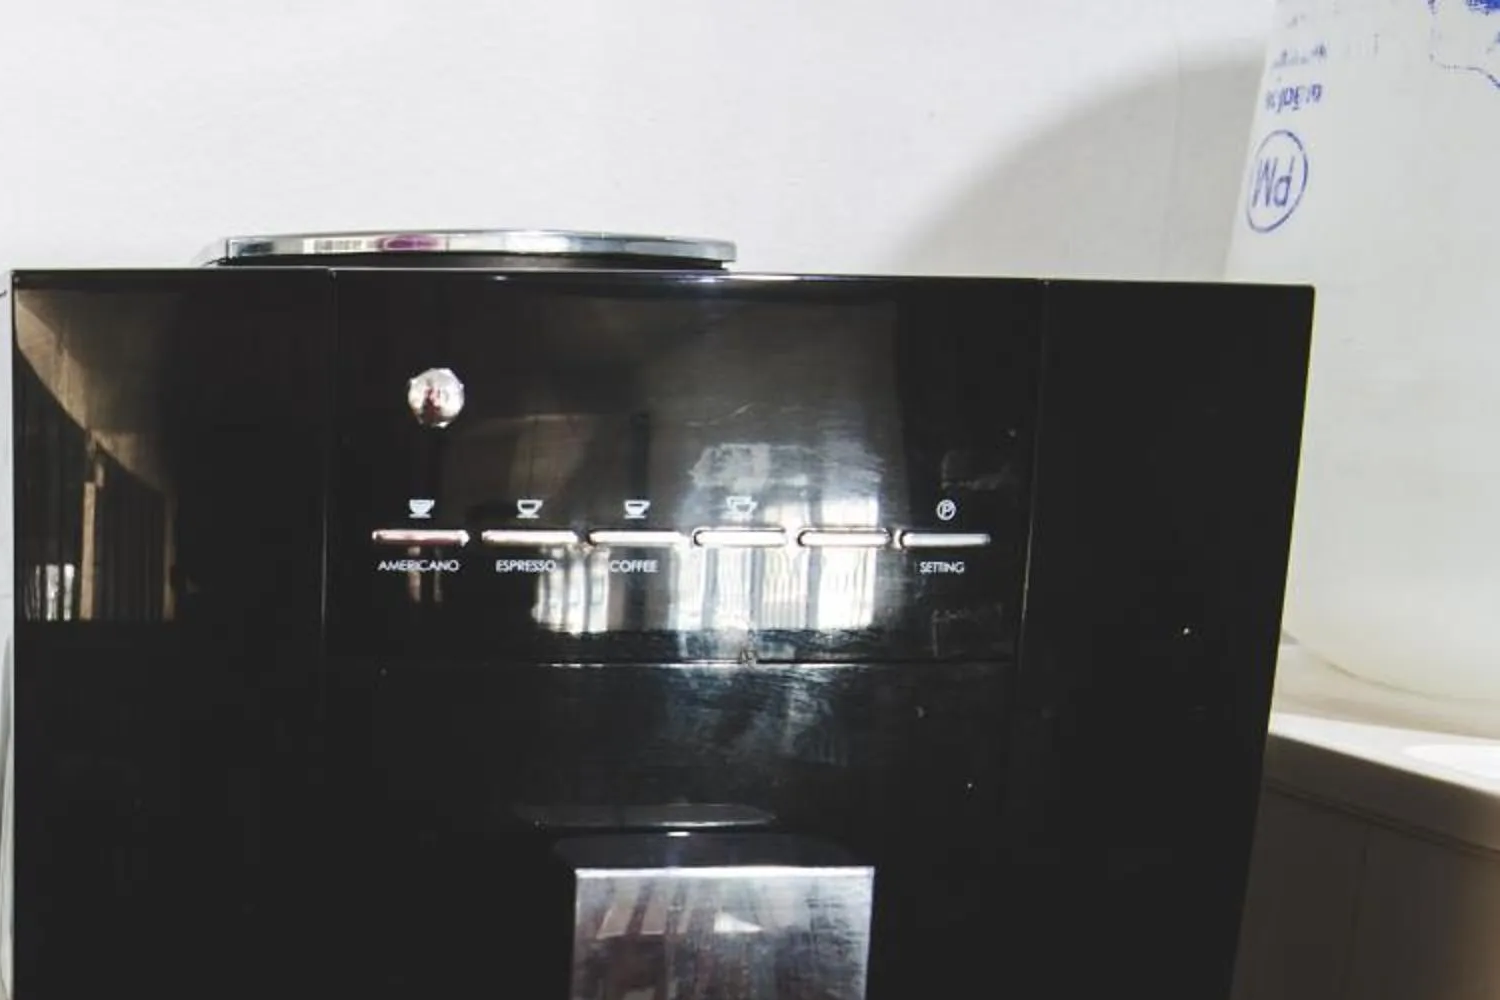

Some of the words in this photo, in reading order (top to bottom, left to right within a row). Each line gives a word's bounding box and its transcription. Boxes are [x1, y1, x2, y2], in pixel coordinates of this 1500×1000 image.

[377, 559, 461, 573] AMERICANO
[495, 559, 557, 573] ESPRESSO
[609, 559, 658, 573] COFFEE
[919, 561, 965, 574] SETTING
